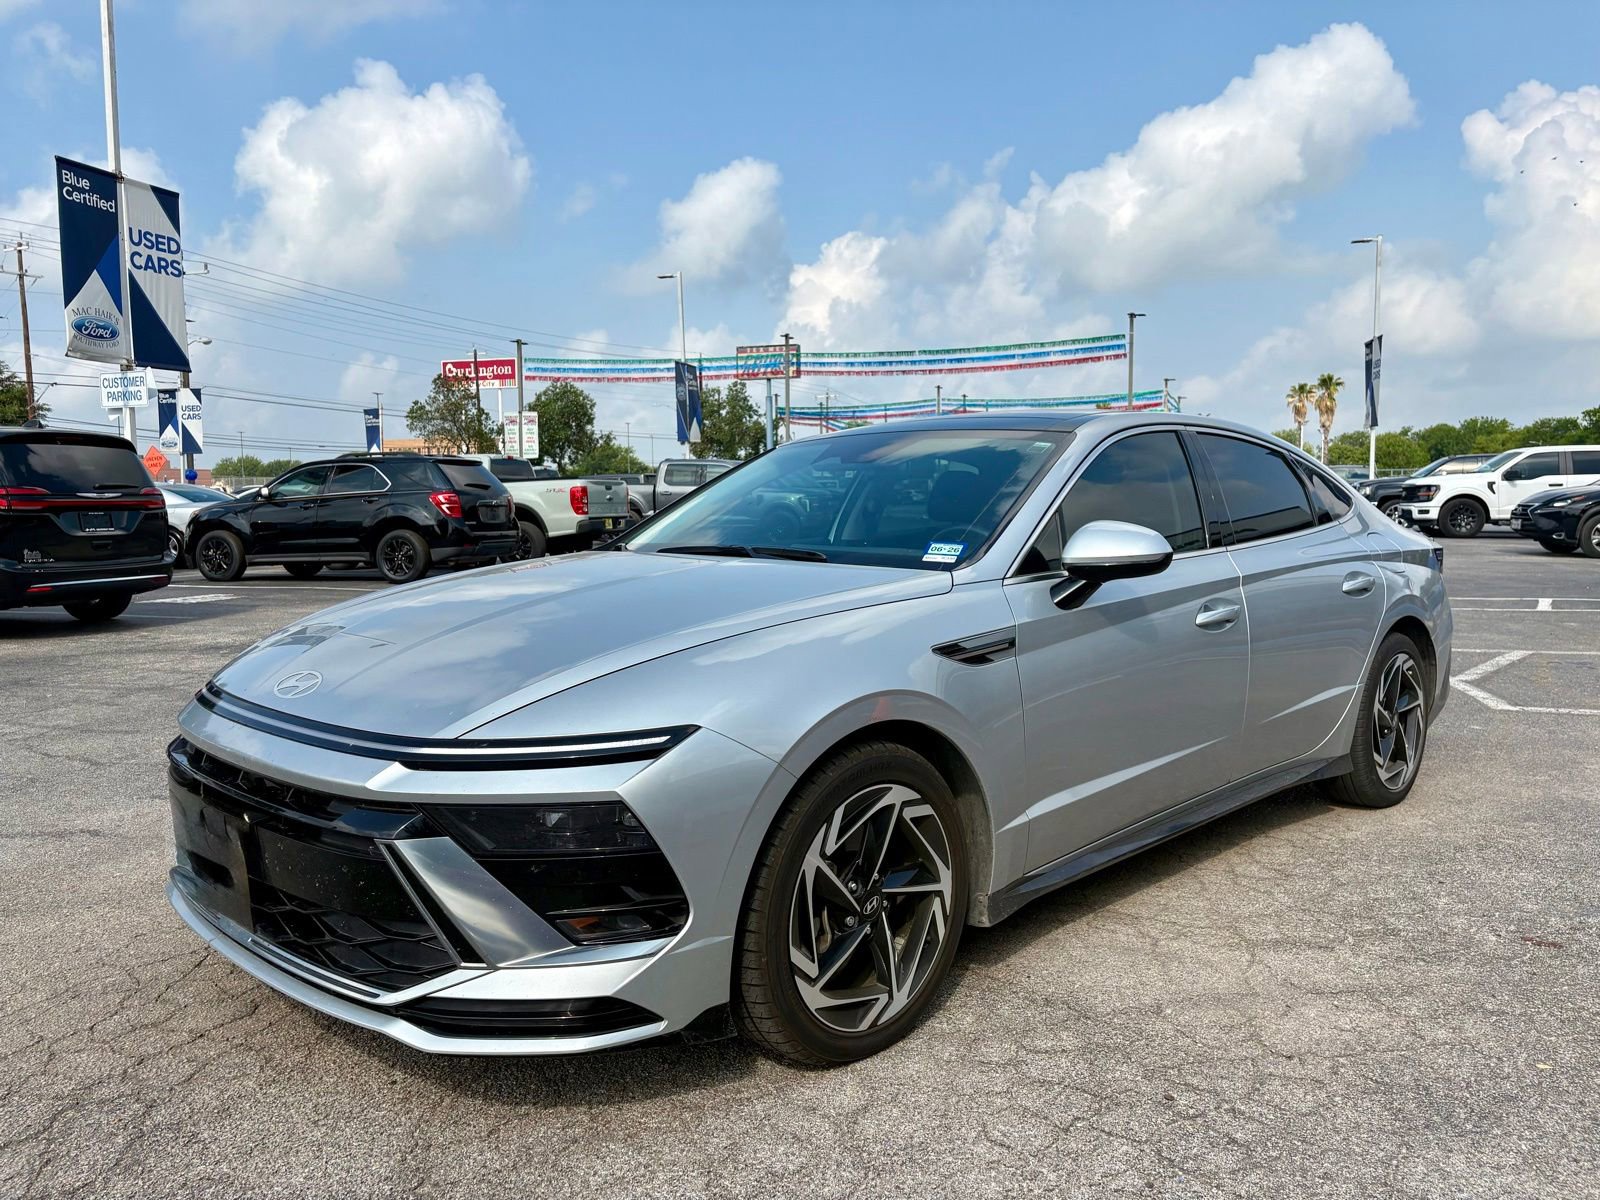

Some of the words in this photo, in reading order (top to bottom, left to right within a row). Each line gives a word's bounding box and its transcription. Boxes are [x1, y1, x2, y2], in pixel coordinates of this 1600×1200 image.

[61, 169, 90, 190] Blue
[62, 186, 116, 213] Certified
[128, 226, 181, 255] USED
[130, 251, 182, 278] CARS
[71, 307, 92, 317] MAC
[81, 319, 113, 338] Ford
[102, 376, 145, 389] CUSTOMER
[107, 389, 143, 402] PARKING
[181, 404, 202, 413] USED
[181, 413, 202, 421] CARS
